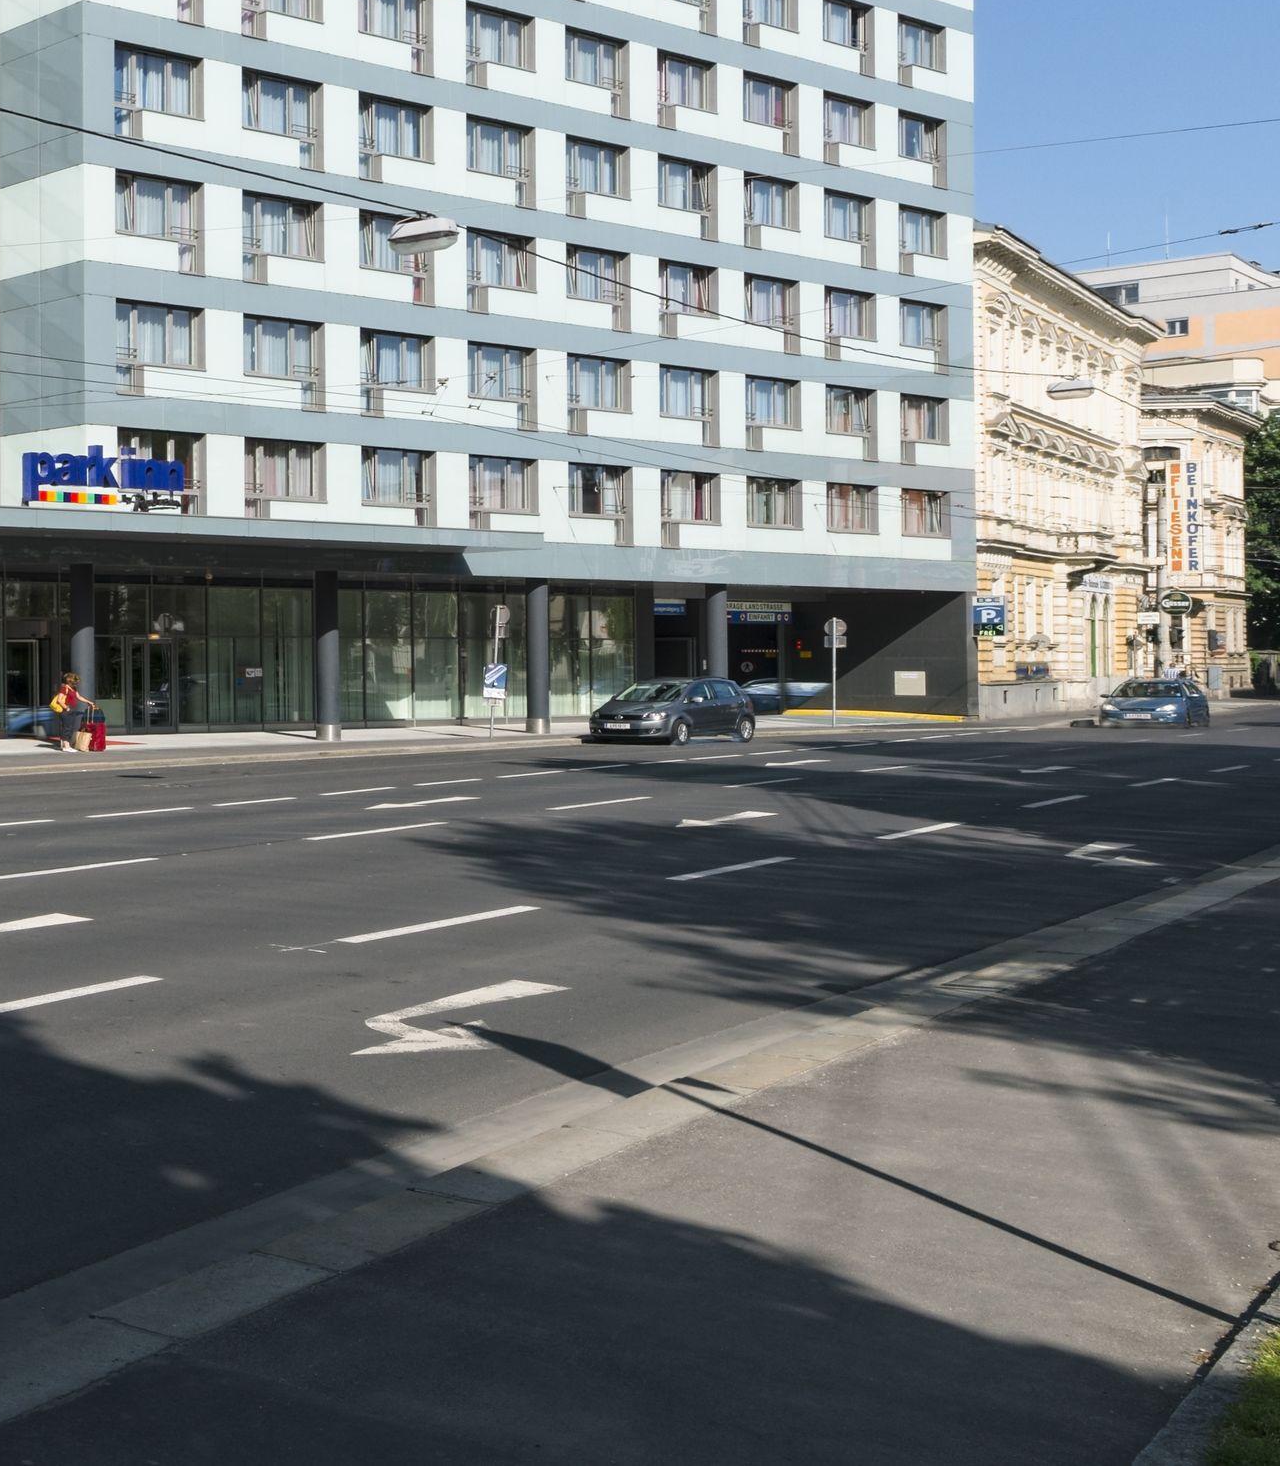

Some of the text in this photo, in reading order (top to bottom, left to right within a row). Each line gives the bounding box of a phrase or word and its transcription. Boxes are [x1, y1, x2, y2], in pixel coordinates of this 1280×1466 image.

[22, 445, 184, 501] park inn
[1170, 476, 1182, 559] FLIESEN
[1186, 463, 1198, 571] BEINKOFER
[745, 603, 783, 611] LANDSTRASSE
[749, 613, 773, 621] EINFAHRT
[981, 609, 996, 623] P
